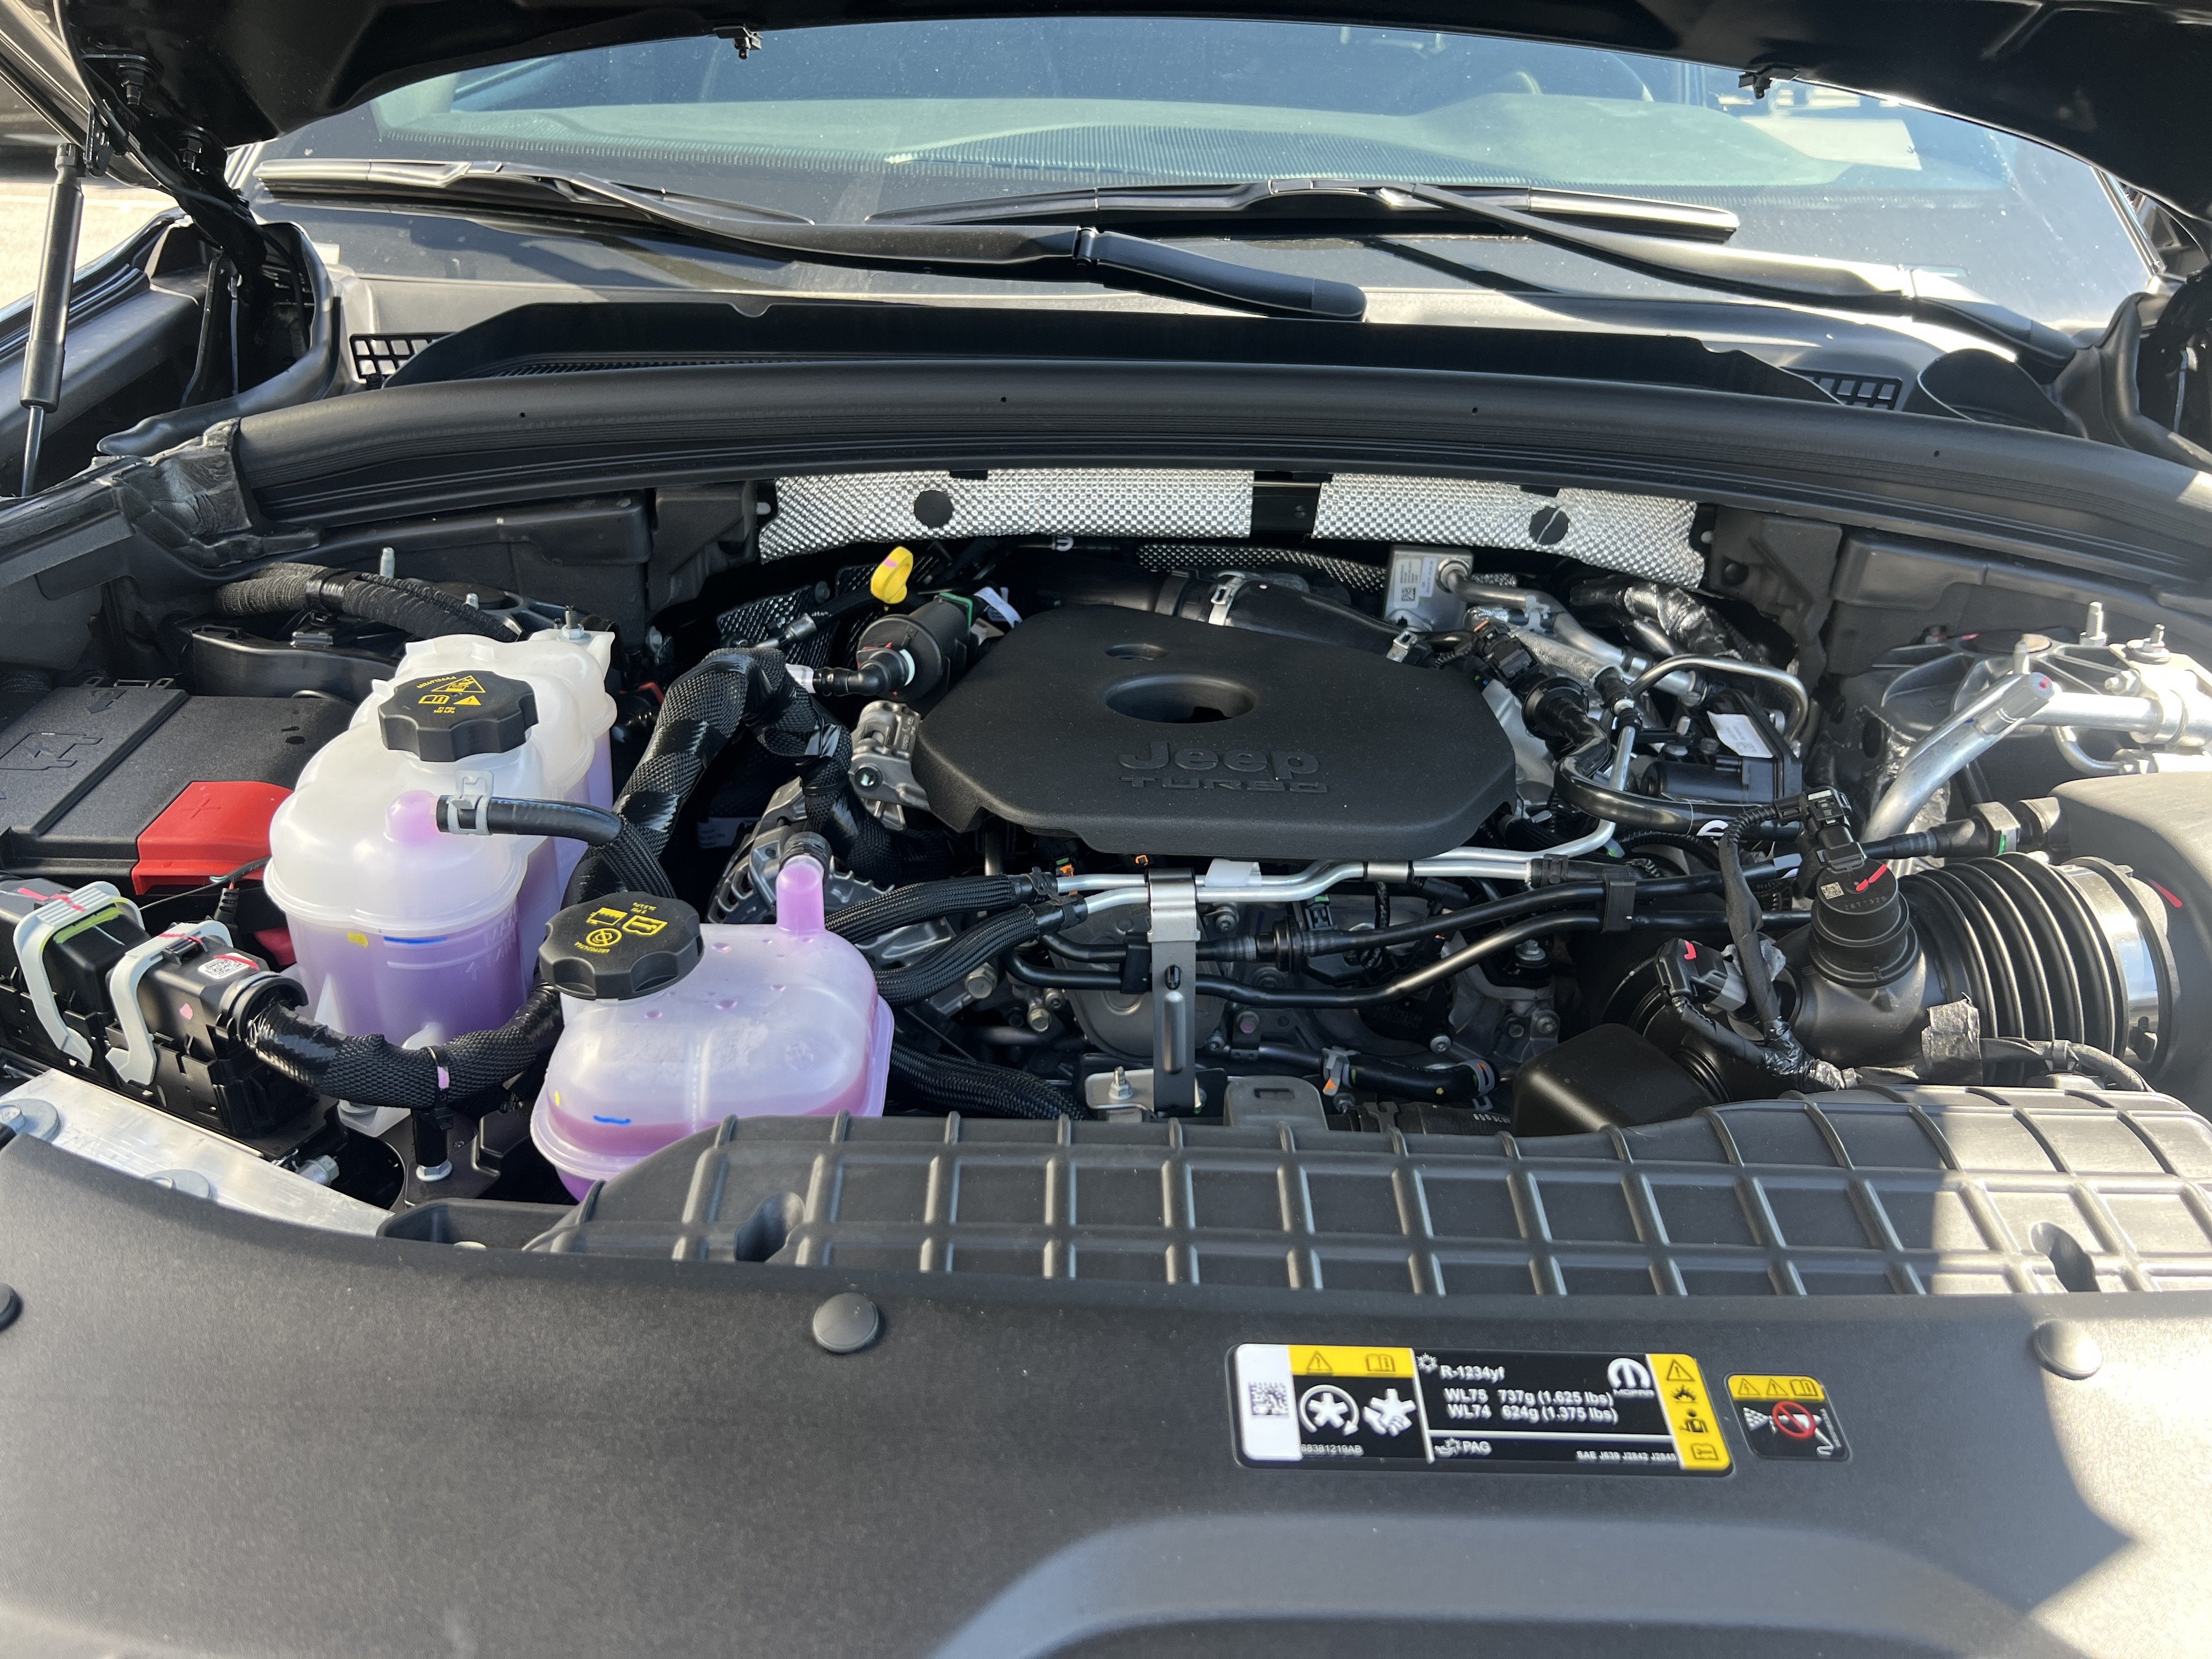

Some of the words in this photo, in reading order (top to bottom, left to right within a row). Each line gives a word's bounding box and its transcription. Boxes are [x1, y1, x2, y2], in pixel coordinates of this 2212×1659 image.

[1118, 741, 1319, 780] Jeep
[1118, 776, 1328, 793] TURBO
[1440, 1364, 1505, 1384] R-1234yf
[1444, 1387, 1488, 1404] WL75
[1497, 1389, 1536, 1408] 737g
[1537, 1390, 1583, 1407] (1.625
[1585, 1391, 1614, 1408] lbs)
[1447, 1403, 1492, 1420] WL74
[1500, 1404, 1539, 1424] 624g
[1541, 1405, 1587, 1423] (1.375
[1589, 1407, 1619, 1425] lbs)
[1463, 1441, 1492, 1455] PAG
